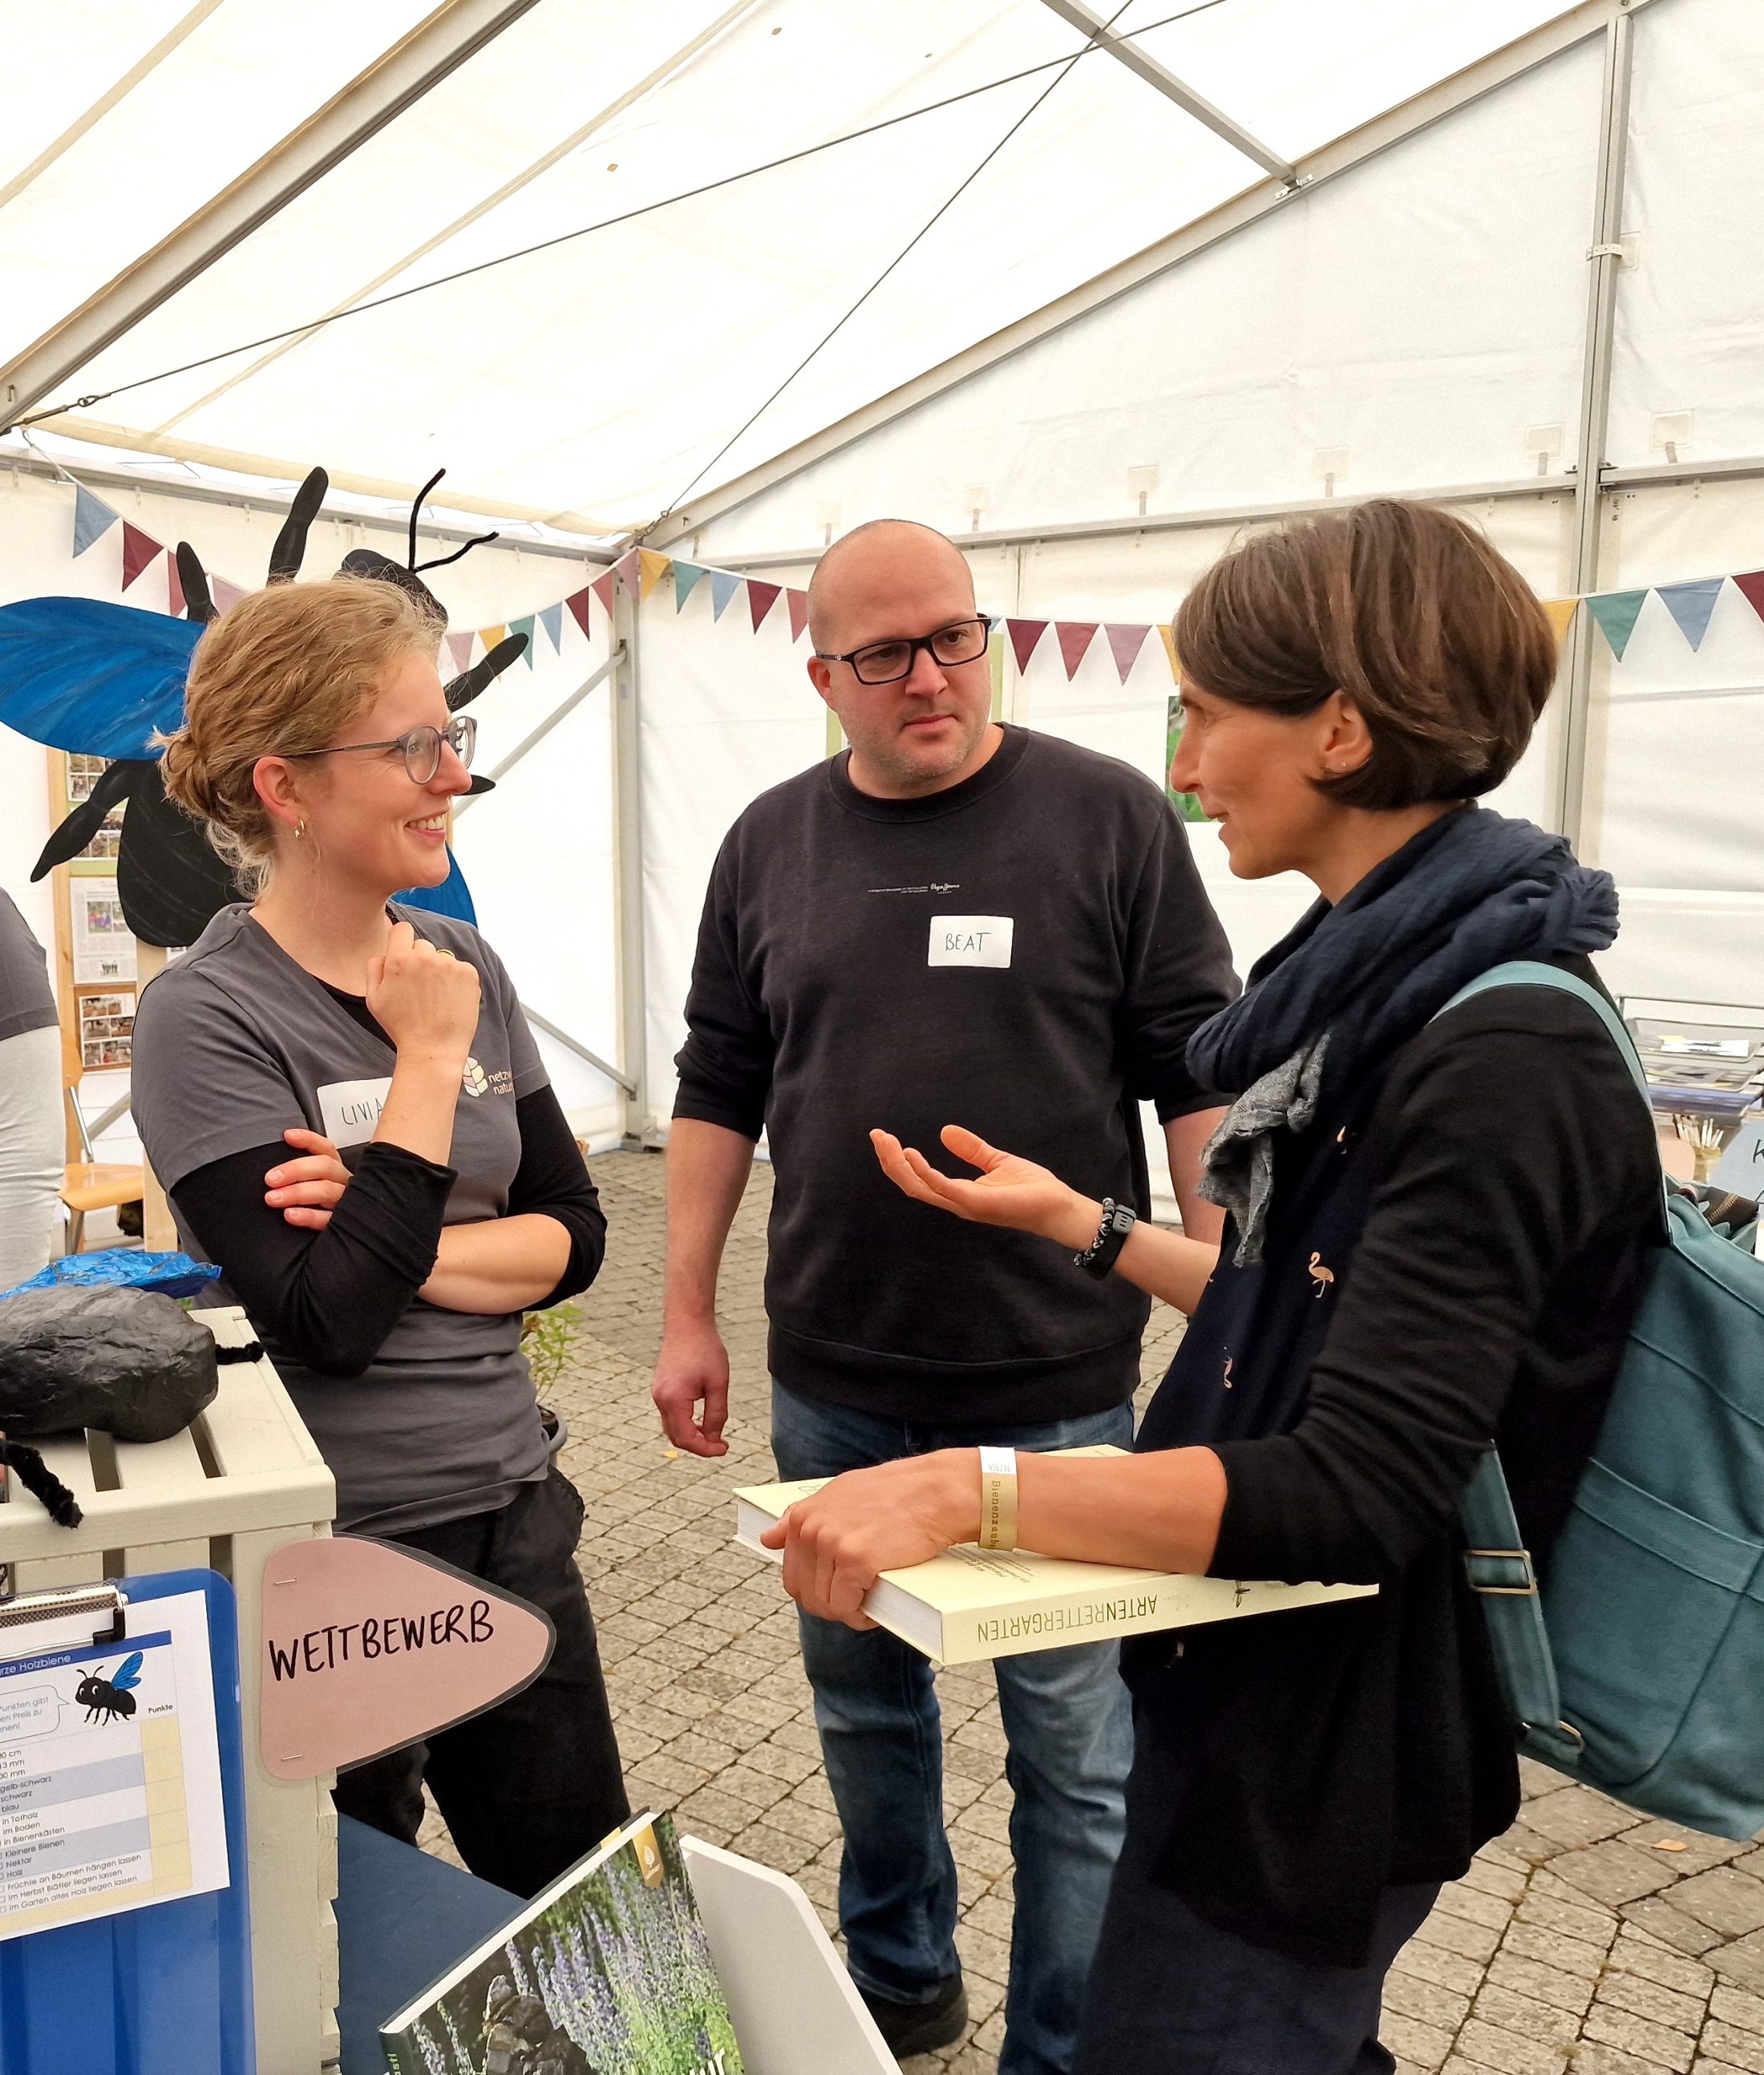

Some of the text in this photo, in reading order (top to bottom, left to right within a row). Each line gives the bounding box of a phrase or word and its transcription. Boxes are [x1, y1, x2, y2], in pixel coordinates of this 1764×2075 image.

[945, 932, 992, 952] BEAT
[341, 1097, 382, 1125] LIVIA
[977, 1595, 1157, 1643] ARTENRETTERGARTEN
[268, 1600, 494, 1681] WETTBEWERB
[19, 1655, 71, 1672] Holzbiene
[13, 1710, 31, 1720] Preis
[148, 1704, 173, 1714] Punkte
[8, 1749, 22, 1757] cm
[9, 1759, 25, 1768] mm
[10, 1769, 26, 1778] mm
[0, 1776, 52, 1794] gelb-schwarz
[0, 1790, 33, 1803] schwarz
[2, 1804, 19, 1813] blau
[11, 1811, 38, 1823] Totholz
[2, 1822, 41, 1835] im Boden
[13, 1826, 65, 1843] Bienenkästen
[5, 1839, 66, 1859] Kleinere Bienen
[6, 1857, 32, 1868] Nektar
[6, 1869, 22, 1879] Holz
[8, 1879, 37, 1891] Früchte
[51, 1868, 84, 1881] Bäumen
[86, 1860, 117, 1873] hängen
[118, 1855, 142, 1865] lassen
[20, 1885, 45, 1899] Herbst
[47, 1881, 71, 1892] Blätter
[73, 1875, 98, 1886] liegen
[99, 1869, 123, 1880] lassen
[21, 1897, 49, 1908] Garten
[51, 1892, 70, 1902] altes
[71, 1887, 87, 1897] Holz
[88, 1882, 113, 1892] liegen
[114, 1876, 138, 1887] lassen
